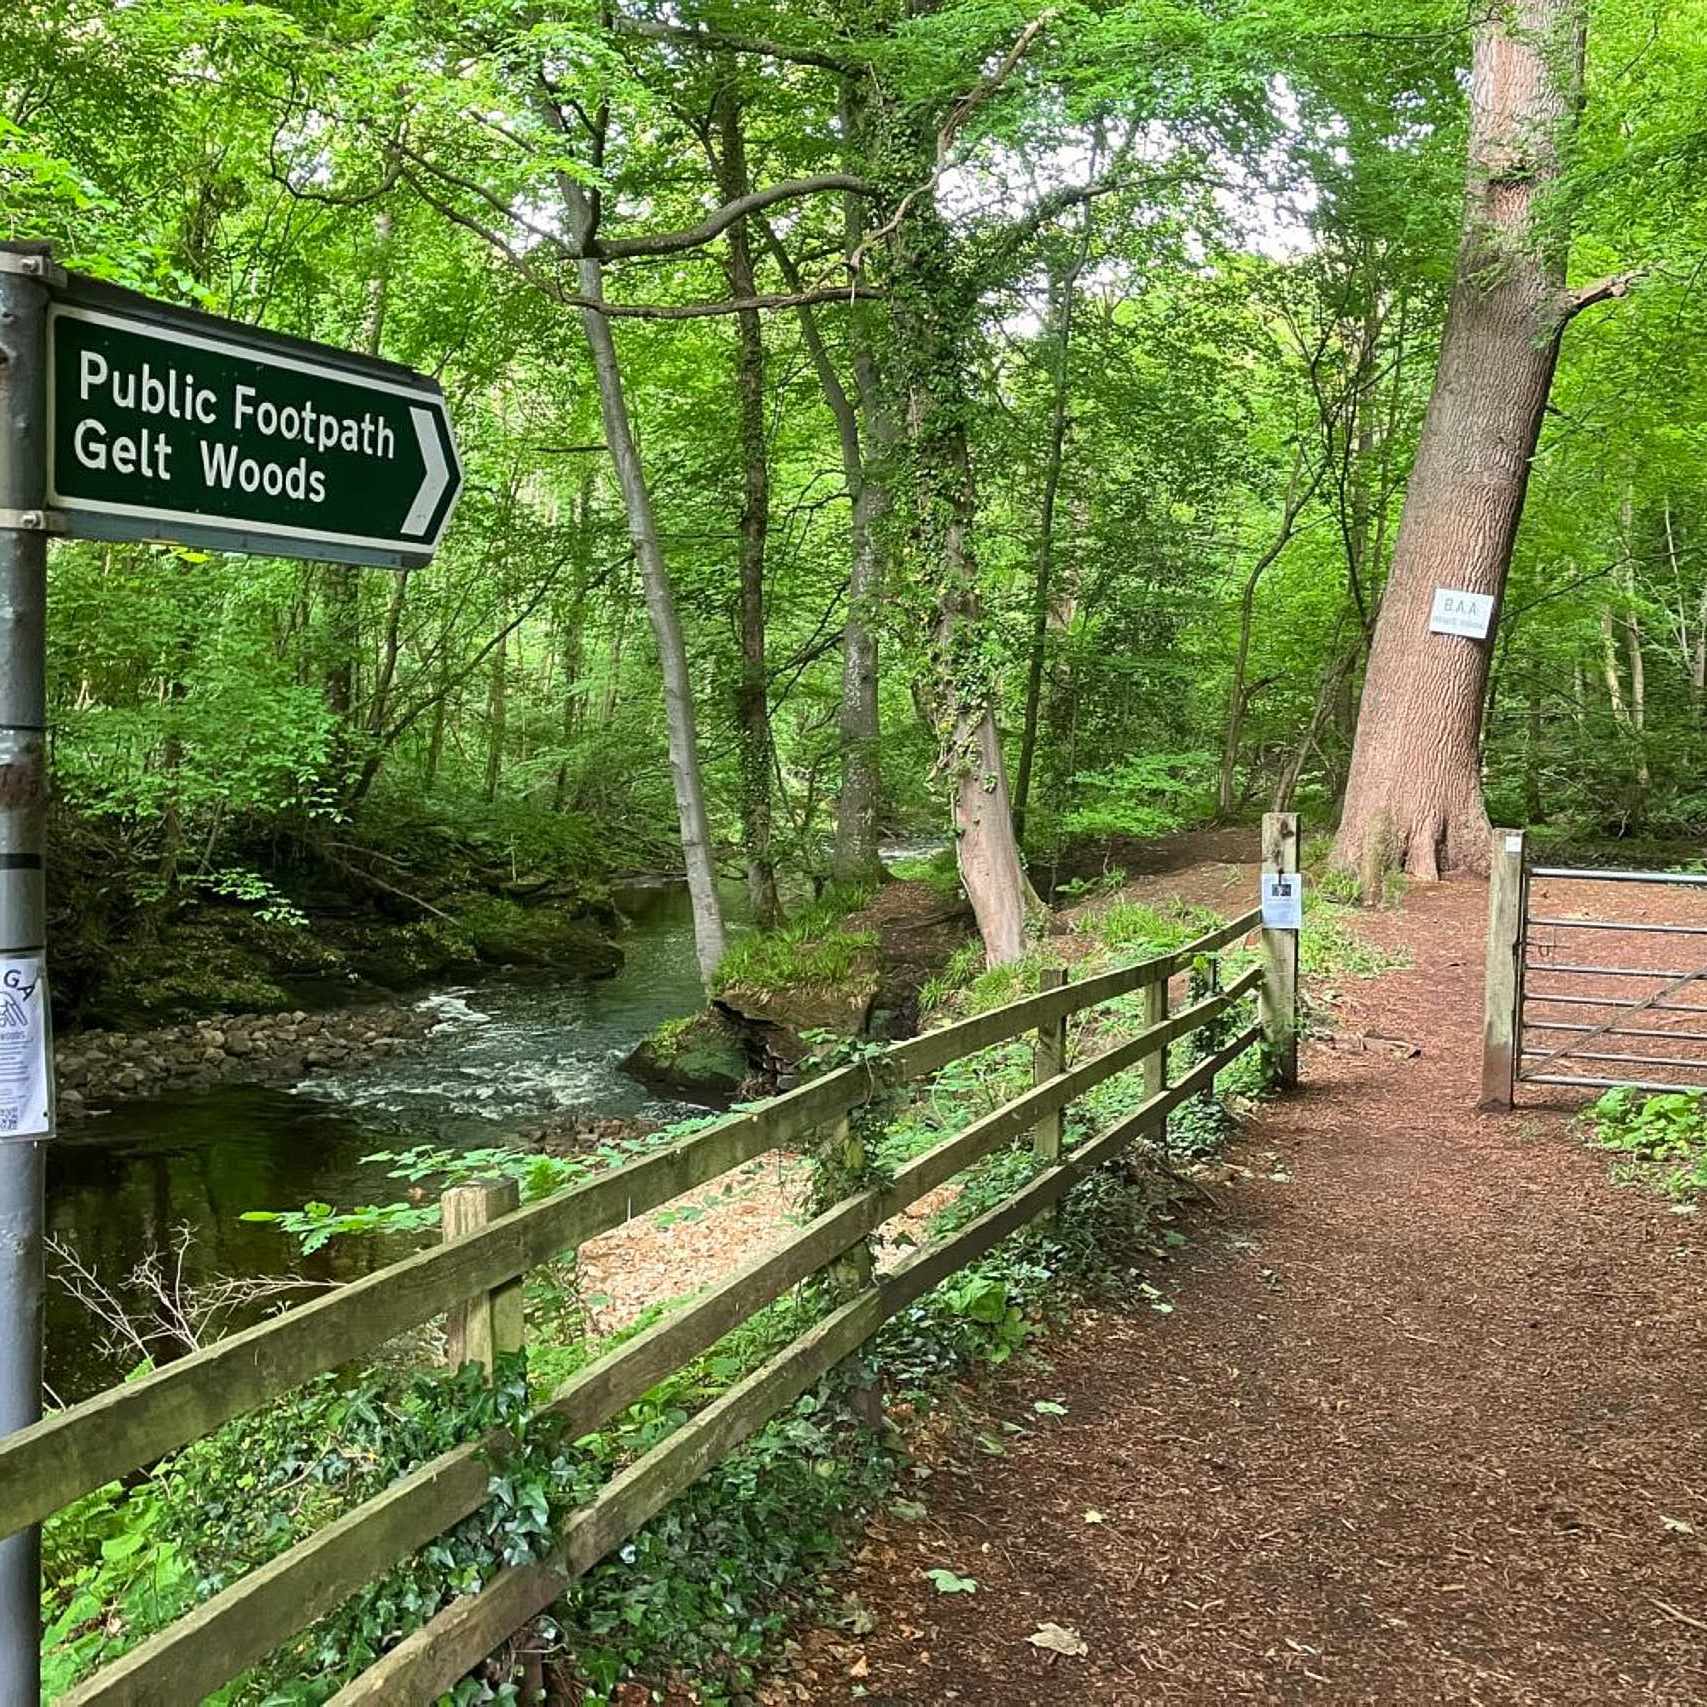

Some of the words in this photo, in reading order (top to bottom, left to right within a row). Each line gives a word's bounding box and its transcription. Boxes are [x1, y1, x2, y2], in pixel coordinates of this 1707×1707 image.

[80, 350, 217, 425] Public
[234, 384, 395, 459] Footpath
[74, 418, 173, 480] Gelt
[200, 439, 326, 503] Woods
